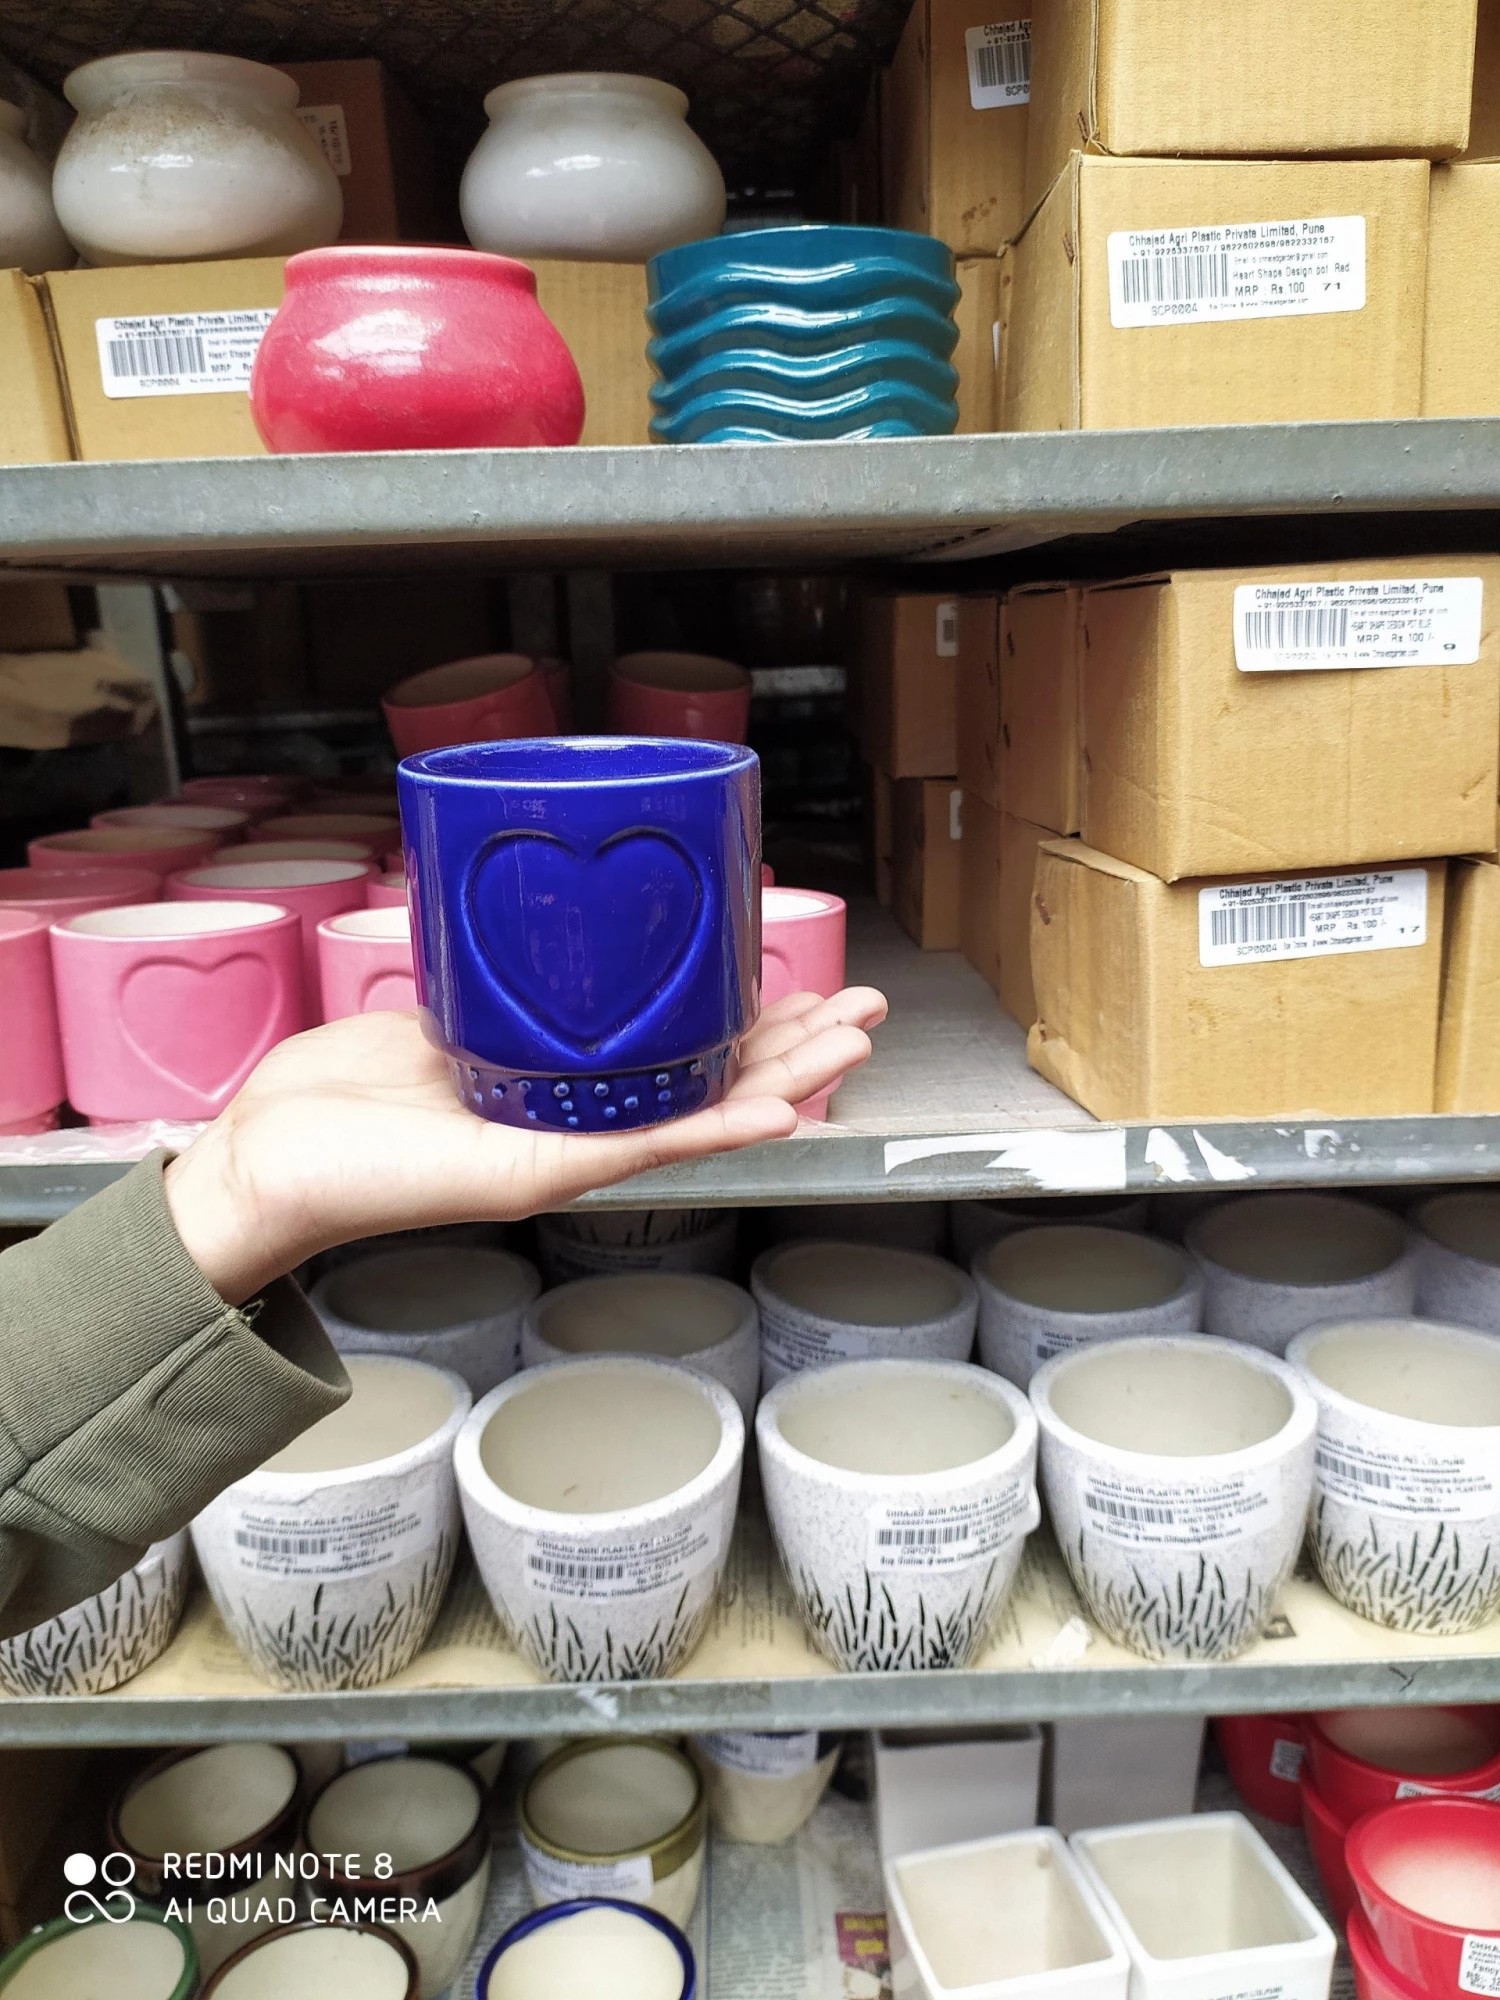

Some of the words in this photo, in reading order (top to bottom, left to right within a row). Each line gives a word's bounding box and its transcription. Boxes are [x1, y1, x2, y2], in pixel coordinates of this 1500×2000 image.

[1129, 233, 1165, 248] Chhajed
[1169, 232, 1187, 246] Agri
[1192, 230, 1221, 242] Plastic
[1225, 228, 1256, 240] Private
[1261, 224, 1298, 238] Limited,
[1303, 223, 1325, 235] Pune
[1233, 269, 1254, 280] Heart
[1258, 267, 1282, 280] Shape
[1286, 266, 1312, 278] Design
[1316, 264, 1328, 275] pot
[1335, 262, 1350, 273] Red
[1234, 285, 1258, 297] MRP
[1255, 588, 1291, 600] Chhajed
[1294, 587, 1312, 600] Agri
[1316, 586, 1344, 597] Plastic
[1348, 585, 1379, 596] Private
[1383, 584, 1418, 595] Limited,
[1422, 583, 1444, 594] Pune
[1356, 634, 1380, 643] MRP
[1408, 632, 1424, 642] 100
[1219, 886, 1252, 899] Chhajed
[1255, 885, 1272, 897] Agri
[1275, 883, 1302, 893] Plastic
[1305, 880, 1333, 891] Private
[1373, 874, 1393, 884] Pune
[1316, 923, 1336, 933] MRP
[1363, 919, 1377, 929] 100
[1470, 1940, 1500, 1952] CHHA
